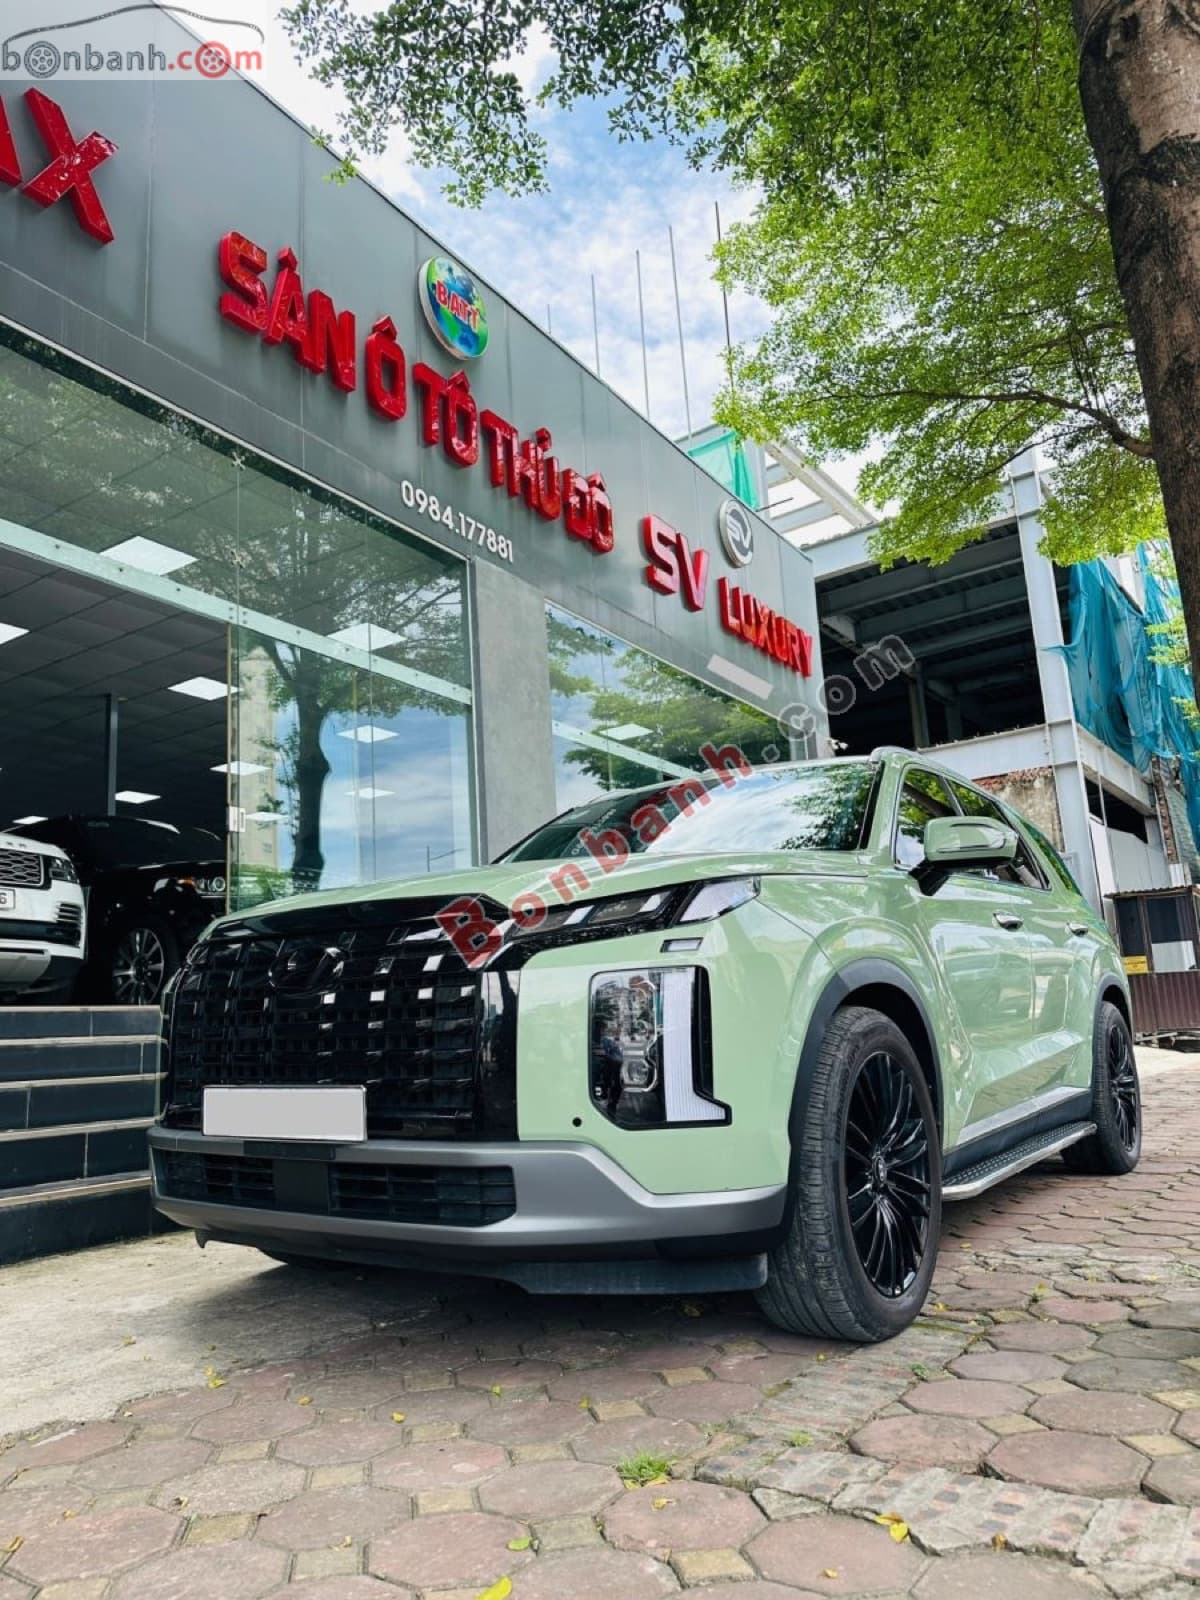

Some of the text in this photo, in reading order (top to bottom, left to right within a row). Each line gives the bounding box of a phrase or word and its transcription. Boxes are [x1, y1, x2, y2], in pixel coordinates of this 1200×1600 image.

[436, 280, 480, 333] BATT
[365, 314, 407, 421] Ô
[412, 362, 479, 467] TÔ
[401, 480, 513, 562] 0984.177881
[642, 514, 813, 677] SV LUXURY
